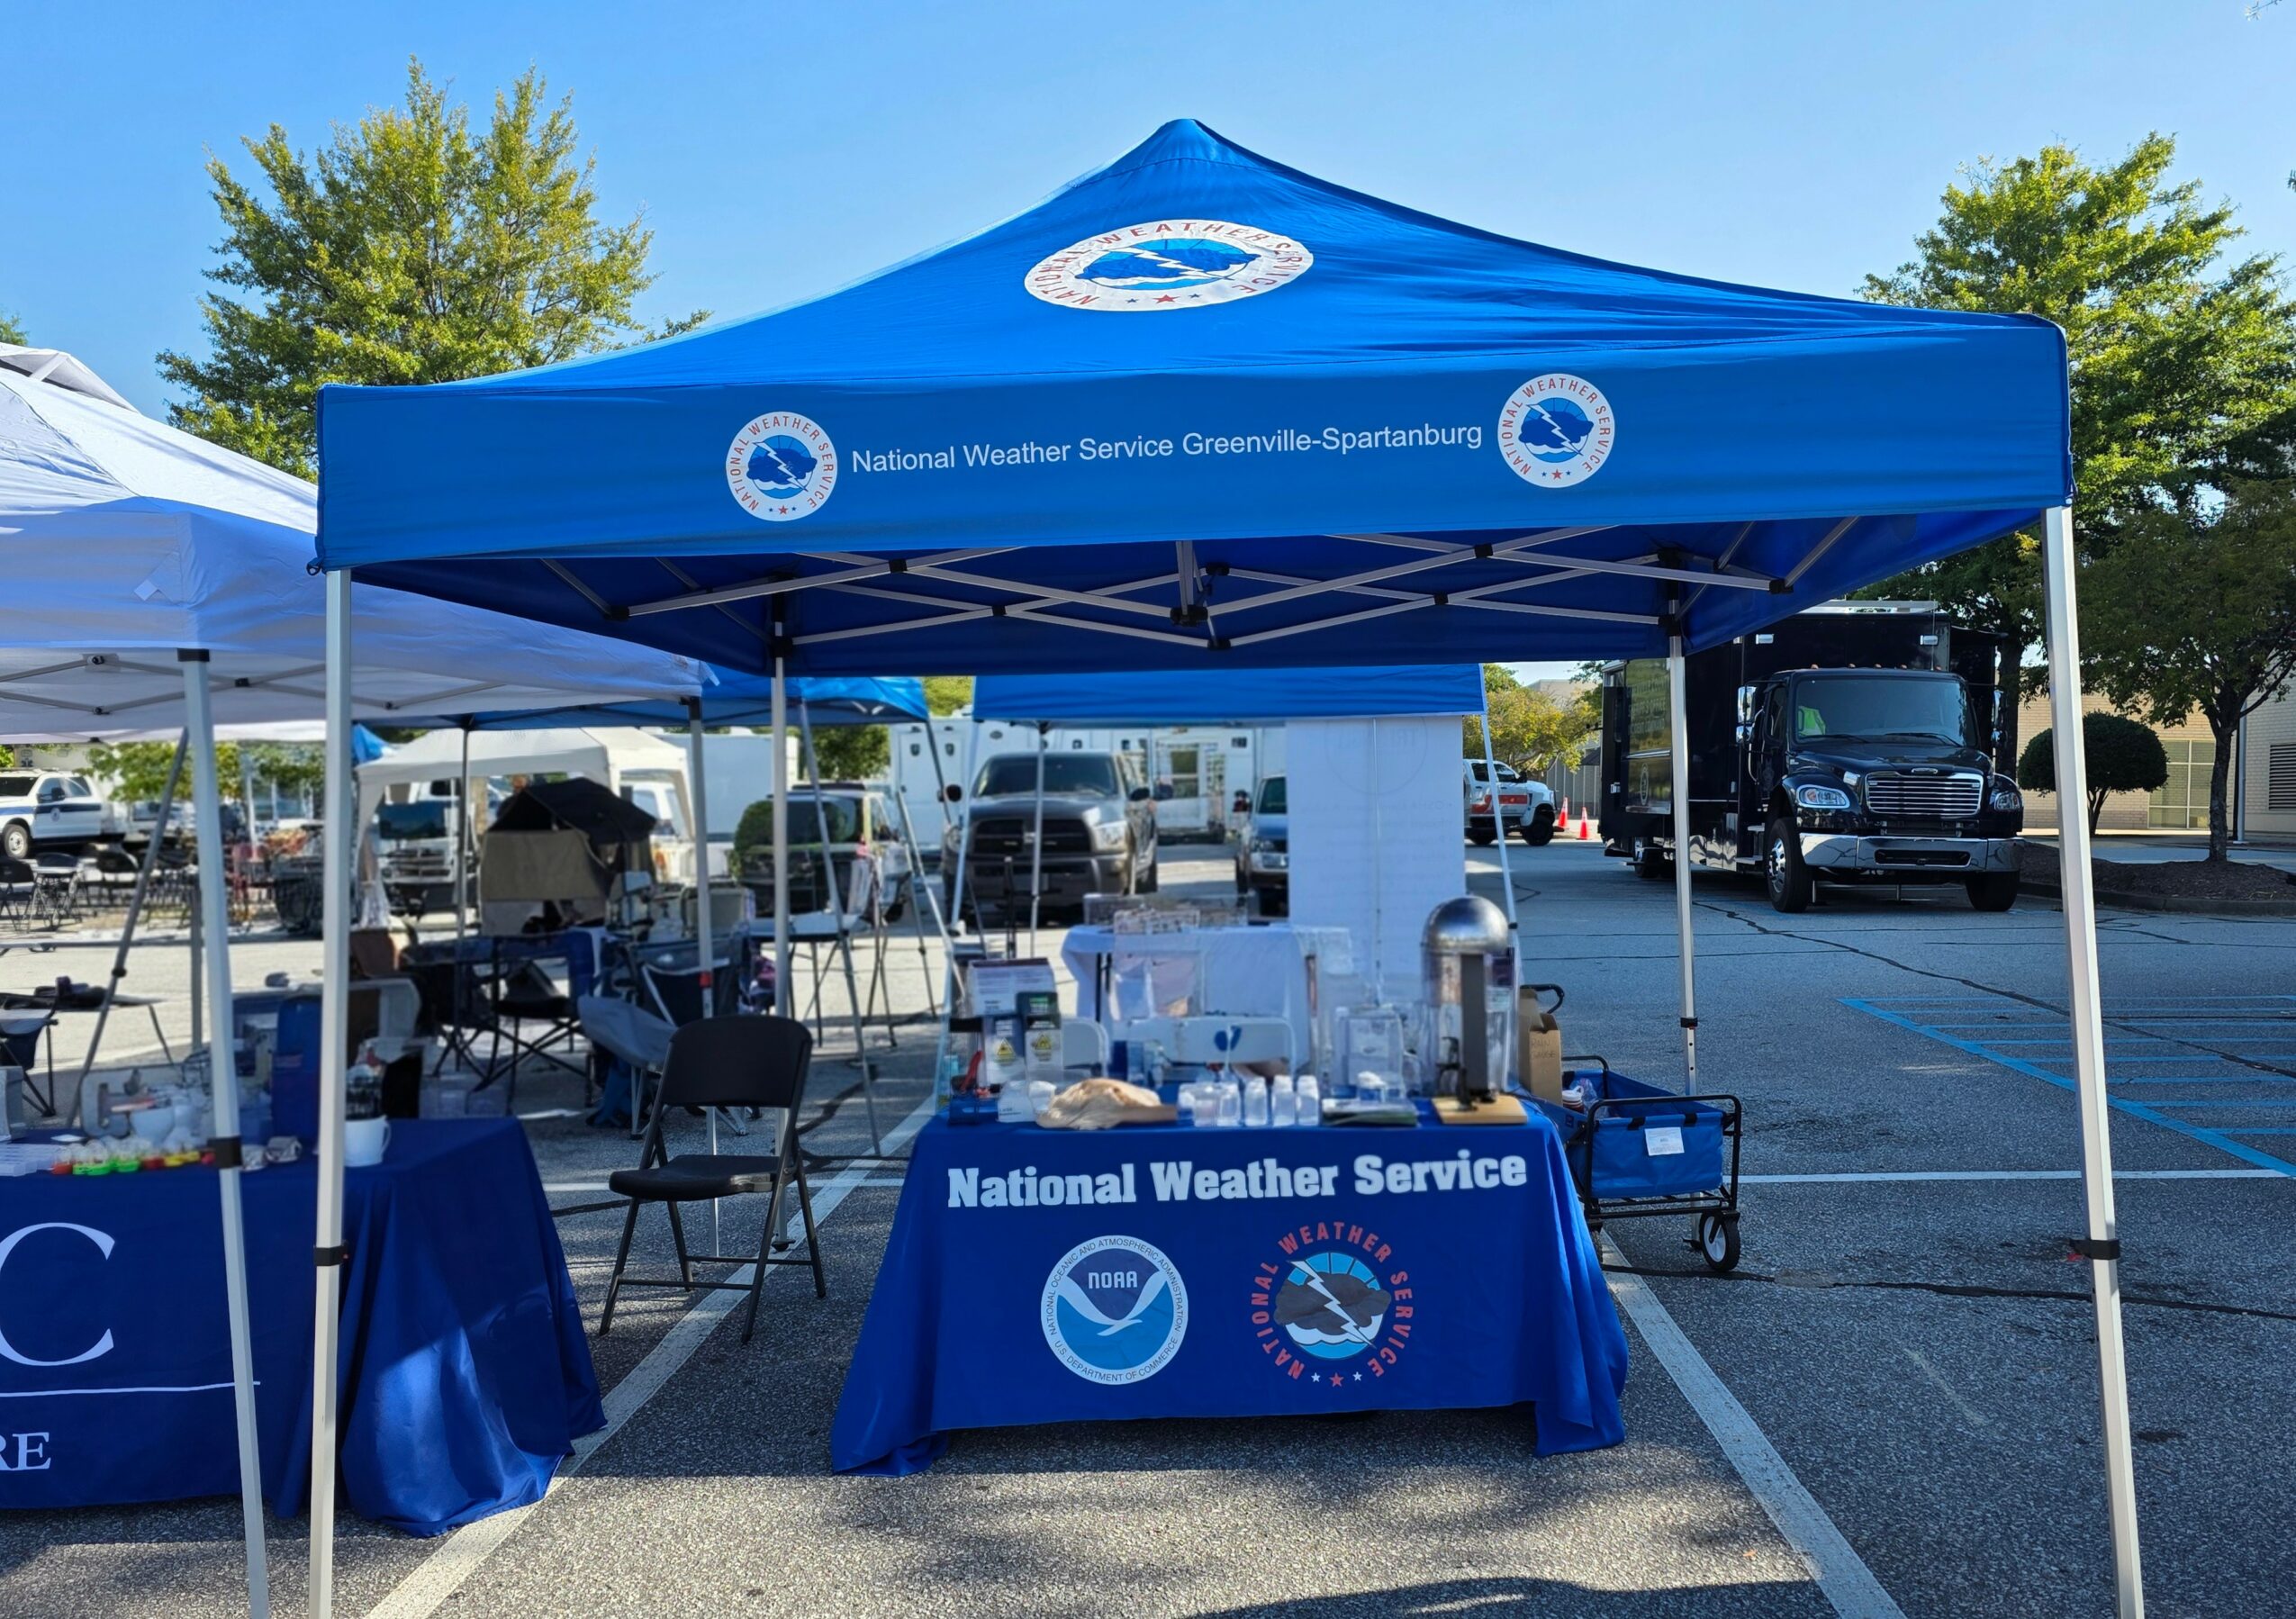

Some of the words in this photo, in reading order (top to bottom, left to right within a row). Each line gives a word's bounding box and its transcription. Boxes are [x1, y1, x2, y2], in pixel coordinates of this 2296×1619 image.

[1035, 248, 1099, 304] NATIONAL
[1094, 222, 1272, 246] WEATHER
[1231, 241, 1304, 294] SERVICE
[852, 445, 955, 473] National
[963, 442, 1071, 466] Weather
[1078, 435, 1173, 461] Service
[1182, 423, 1482, 456] Greenville-Spartanburg
[1502, 400, 1532, 475] NATIONAL
[1522, 377, 1598, 405] WEATHER
[1581, 404, 1611, 474] SERVICE
[730, 438, 759, 511] NATIONAL
[748, 415, 820, 441] WEATHER
[807, 441, 834, 509] SERVICE
[948, 1164, 1136, 1207] National
[1150, 1158, 1338, 1201] Weather
[1354, 1149, 1528, 1195] Service
[1079, 1242, 1096, 1256] AND
[1098, 1238, 1159, 1261] ATMOSPHERIC
[1277, 1221, 1392, 1263] WEATHER
[1051, 1253, 1079, 1288] OCEANIC
[1088, 1271, 1138, 1289] NOAA
[1157, 1258, 1183, 1333] ADMINISTRATION
[1045, 1289, 1058, 1335] NATIONAL
[1251, 1261, 1306, 1379] NATIONAL
[1367, 1271, 1415, 1378] SERVICE
[1054, 1340, 1067, 1357] U.S.
[1066, 1355, 1127, 1382] DEPARTMENT
[1125, 1370, 1138, 1380] OF
[1138, 1336, 1179, 1377] COMMERCE
